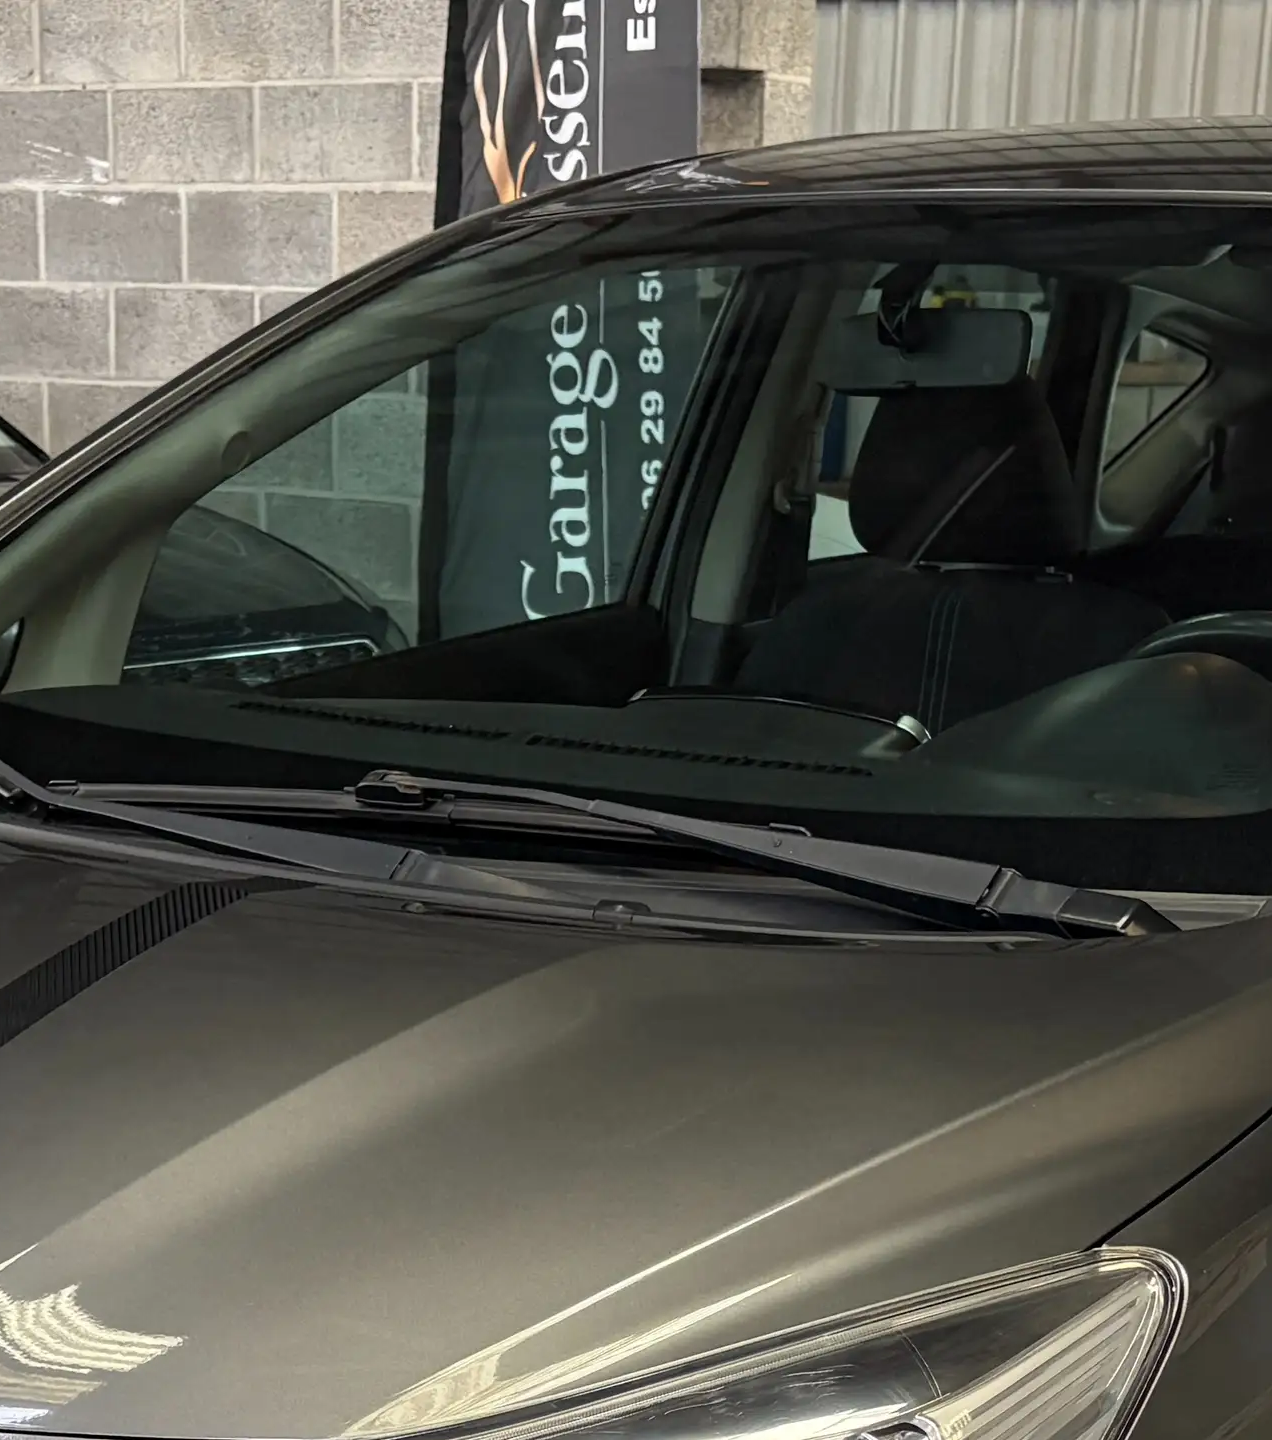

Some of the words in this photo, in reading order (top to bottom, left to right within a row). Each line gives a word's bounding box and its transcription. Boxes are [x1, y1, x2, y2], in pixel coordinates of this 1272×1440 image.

[545, 0, 589, 181] ssen
[638, 317, 664, 374] 84
[521, 303, 618, 619] Garage
[639, 395, 665, 444] 29
